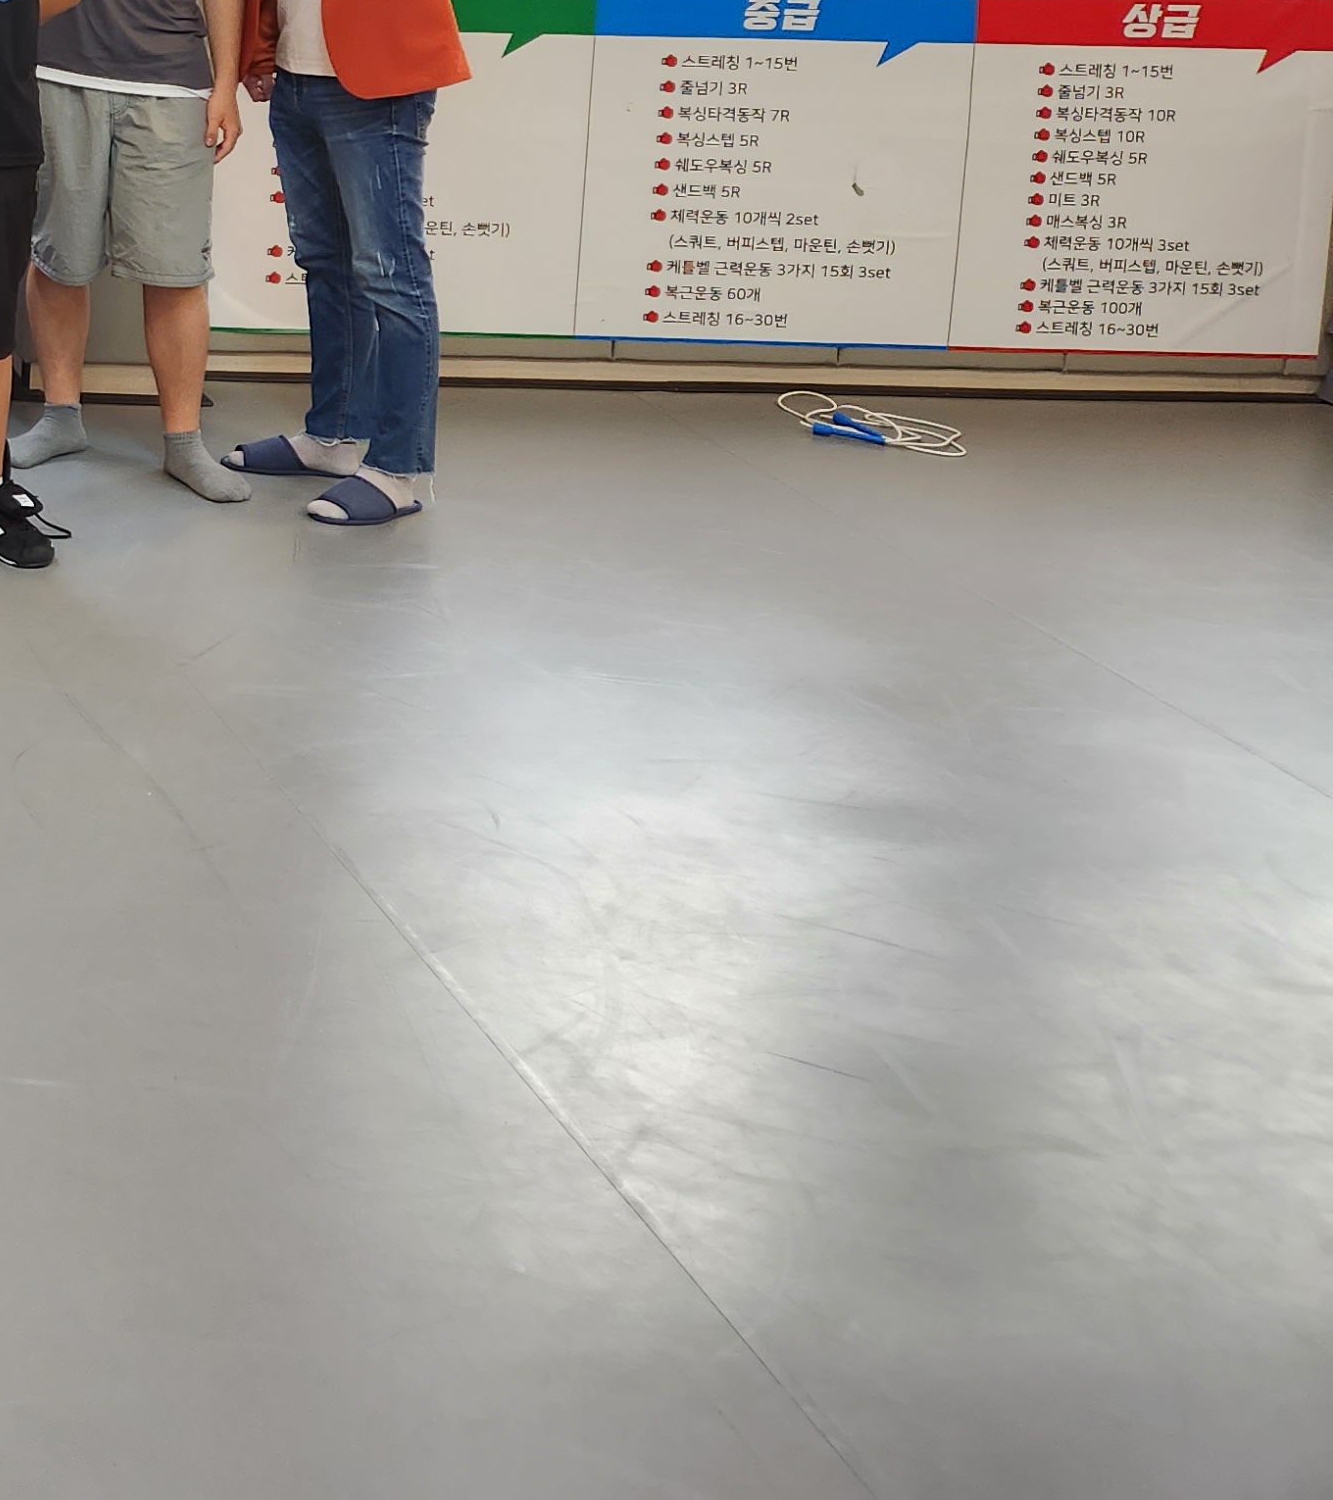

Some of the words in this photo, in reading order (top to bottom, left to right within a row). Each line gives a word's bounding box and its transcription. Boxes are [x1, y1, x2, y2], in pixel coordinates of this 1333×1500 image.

[1122, 4, 1202, 39] 상급
[682, 55, 739, 70] 스트레칭
[746, 57, 797, 71] 1~15번
[1059, 64, 1116, 79] 스트레칭
[1123, 65, 1173, 79] 1~15번
[680, 80, 722, 95] 줄넘기
[728, 82, 747, 94] 3R
[1058, 85, 1100, 100] 줄넘기
[1105, 86, 1124, 98] 3R
[678, 107, 765, 123] 복싱타격동작
[771, 110, 789, 122] 7R
[1056, 107, 1142, 123] 복싱타격동작
[1149, 110, 1175, 122] 10R
[677, 132, 734, 147] 복싱스텝
[740, 135, 759, 146] 5R
[1055, 128, 1111, 143] 복싱스텝
[1118, 130, 1145, 143] 10R
[675, 158, 747, 174] 쉐도우복싱
[753, 161, 771, 173] 5R
[1052, 150, 1123, 166] 쉐도우복싱
[1128, 152, 1147, 164] 5R
[1050, 171, 1092, 187] 샌드백
[1097, 173, 1116, 185] 5R
[673, 183, 716, 199] 샌드백
[721, 186, 740, 198] 5R
[1049, 193, 1076, 207] 미트
[1081, 194, 1100, 206] 3R
[671, 209, 728, 225] 체력운동
[735, 212, 781, 226] 10개씩
[786, 213, 818, 226] 2set
[1047, 215, 1102, 230] 매스복싱
[1108, 217, 1126, 228] 3R
[1044, 236, 1101, 251] 체력운동
[1108, 237, 1153, 252] 10개씩
[1158, 239, 1189, 252] 3set
[667, 260, 709, 275] 케틀벨
[715, 262, 772, 277] 근력운동
[777, 264, 814, 278] 3가지
[822, 265, 853, 279] 15회
[859, 267, 891, 279] 3set
[665, 285, 722, 301] 복근운동
[728, 288, 760, 302] 60개
[1040, 278, 1082, 293] 케틀벨
[1087, 280, 1144, 295] 근력운동
[1149, 281, 1185, 295] 3가지
[1193, 282, 1223, 296] 15회
[1228, 283, 1260, 296] 3set
[1038, 300, 1095, 315] 복근운동
[1101, 302, 1142, 316] 100개
[663, 311, 720, 326] 스트레칭
[727, 314, 787, 328] 16~30번
[1036, 321, 1092, 336] 스트레칭
[1099, 324, 1158, 337] 16~30번
